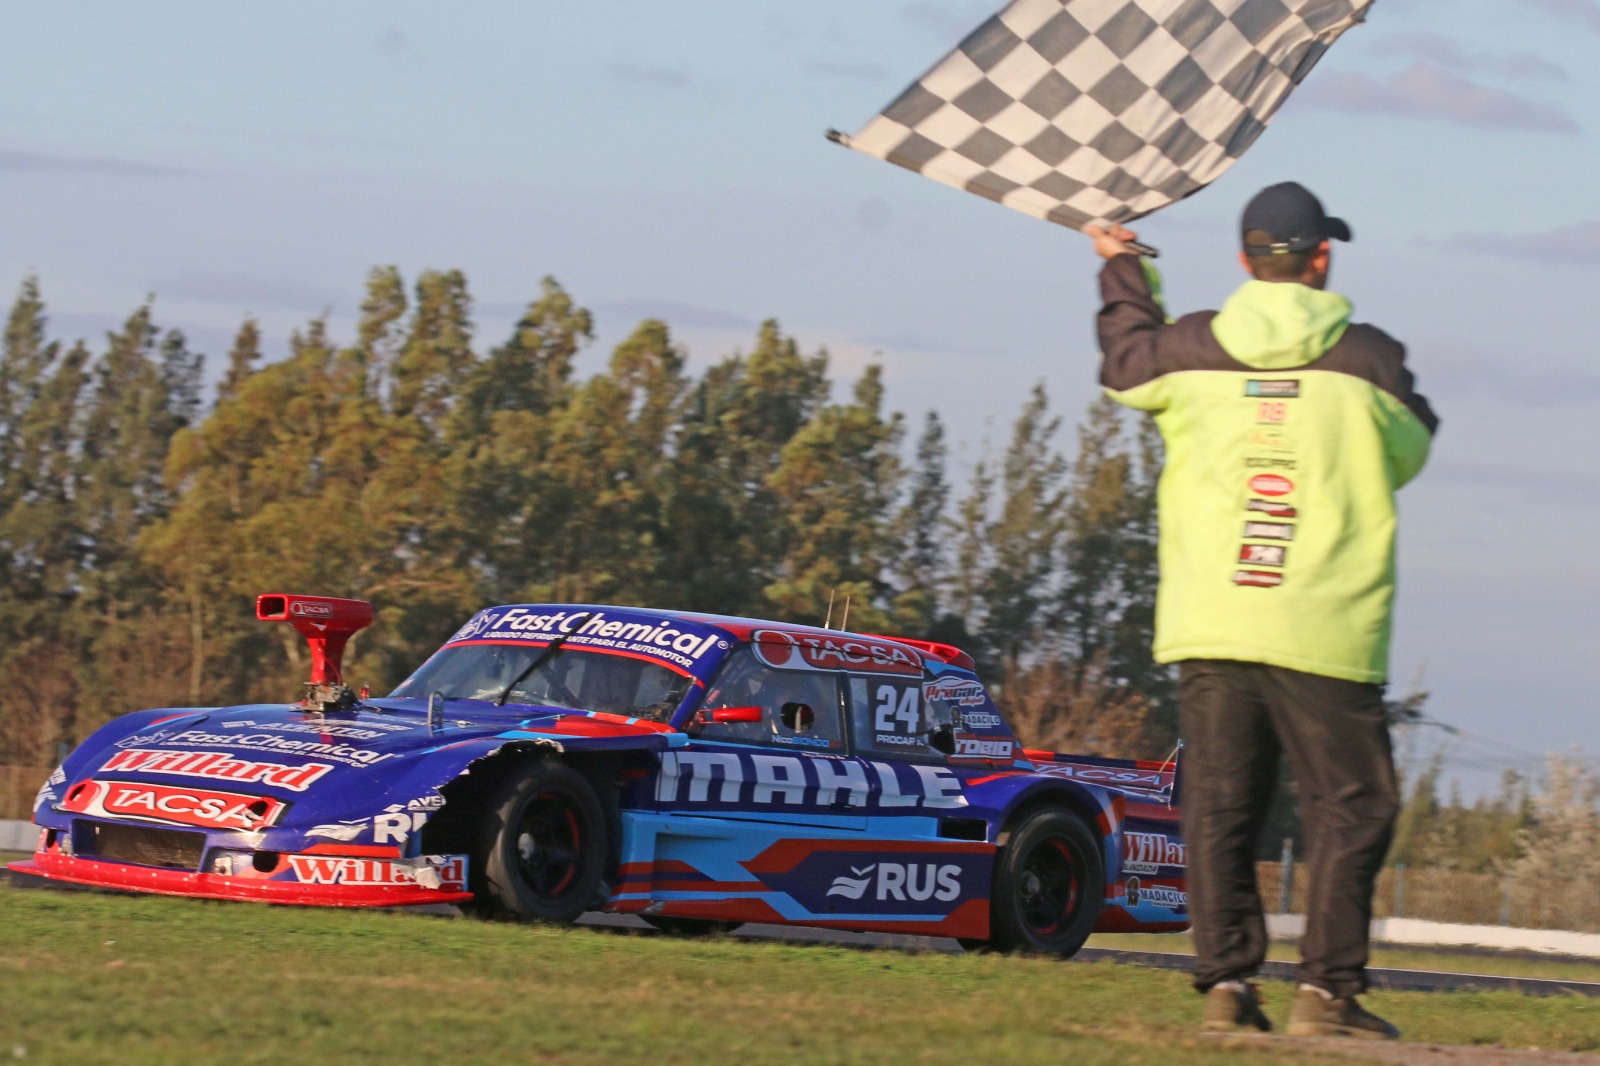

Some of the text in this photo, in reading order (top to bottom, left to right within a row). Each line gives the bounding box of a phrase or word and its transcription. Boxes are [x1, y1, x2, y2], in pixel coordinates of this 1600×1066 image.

[302, 604, 330, 615] TACSA
[590, 636, 615, 647] PARA
[617, 641, 627, 650] EL
[627, 643, 694, 668] AUTOMOTOR
[803, 637, 917, 667] TACSA
[874, 684, 920, 734] 24
[876, 734, 916, 746] PROCAR
[101, 749, 333, 791] Willard
[654, 751, 970, 809] MAHLE
[1034, 764, 1161, 786] TACSA
[112, 788, 254, 828] TACSA
[407, 795, 446, 808] AVE
[876, 862, 963, 902] RUS
